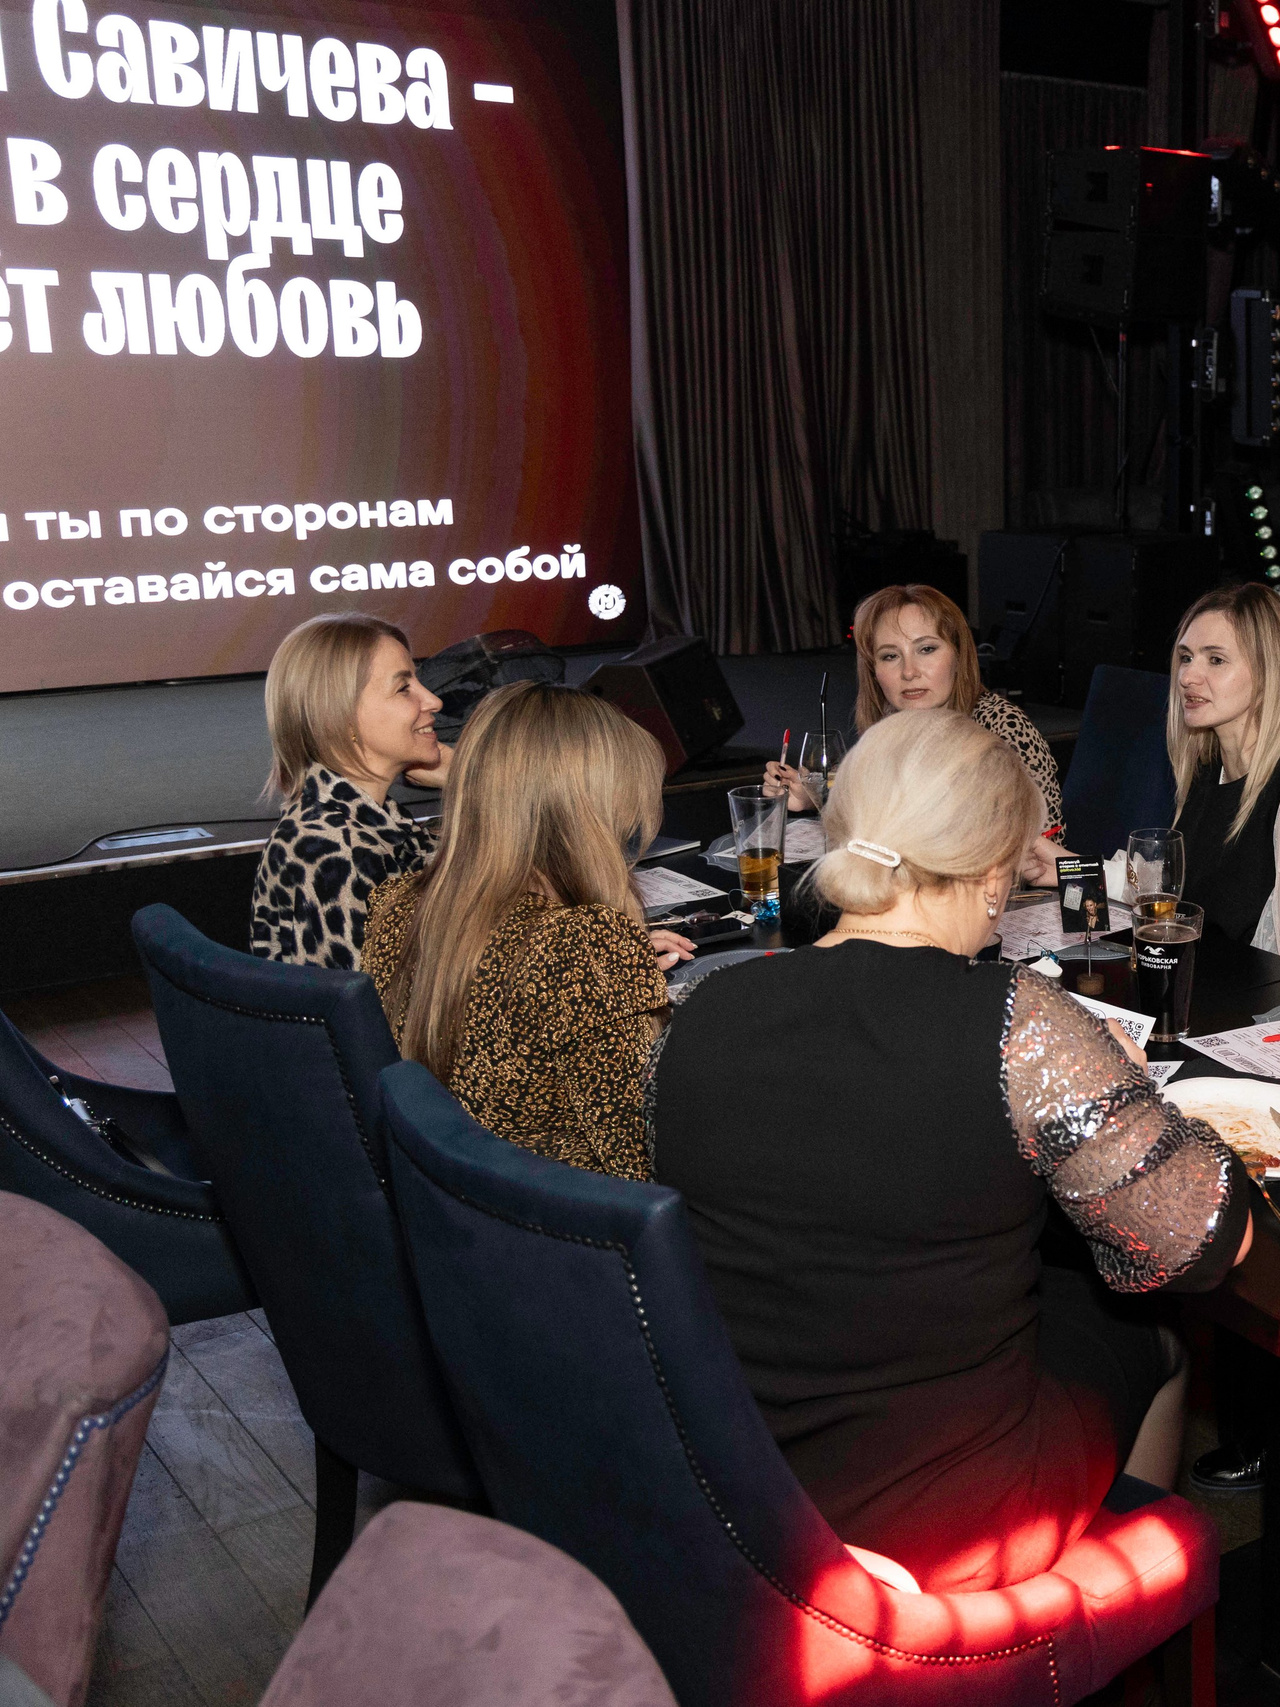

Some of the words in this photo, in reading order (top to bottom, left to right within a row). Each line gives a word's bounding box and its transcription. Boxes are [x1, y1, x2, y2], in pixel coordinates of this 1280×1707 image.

[32, 0, 454, 130] Савичева
[6, 137, 69, 226] в
[93, 143, 404, 261] сердце
[82, 253, 423, 358] любовь
[25, 510, 102, 541] ты
[119, 507, 188, 538] по
[203, 499, 454, 540] сторонам
[2, 561, 296, 611] оставайся
[309, 560, 436, 593] сама
[448, 544, 586, 585] собой
